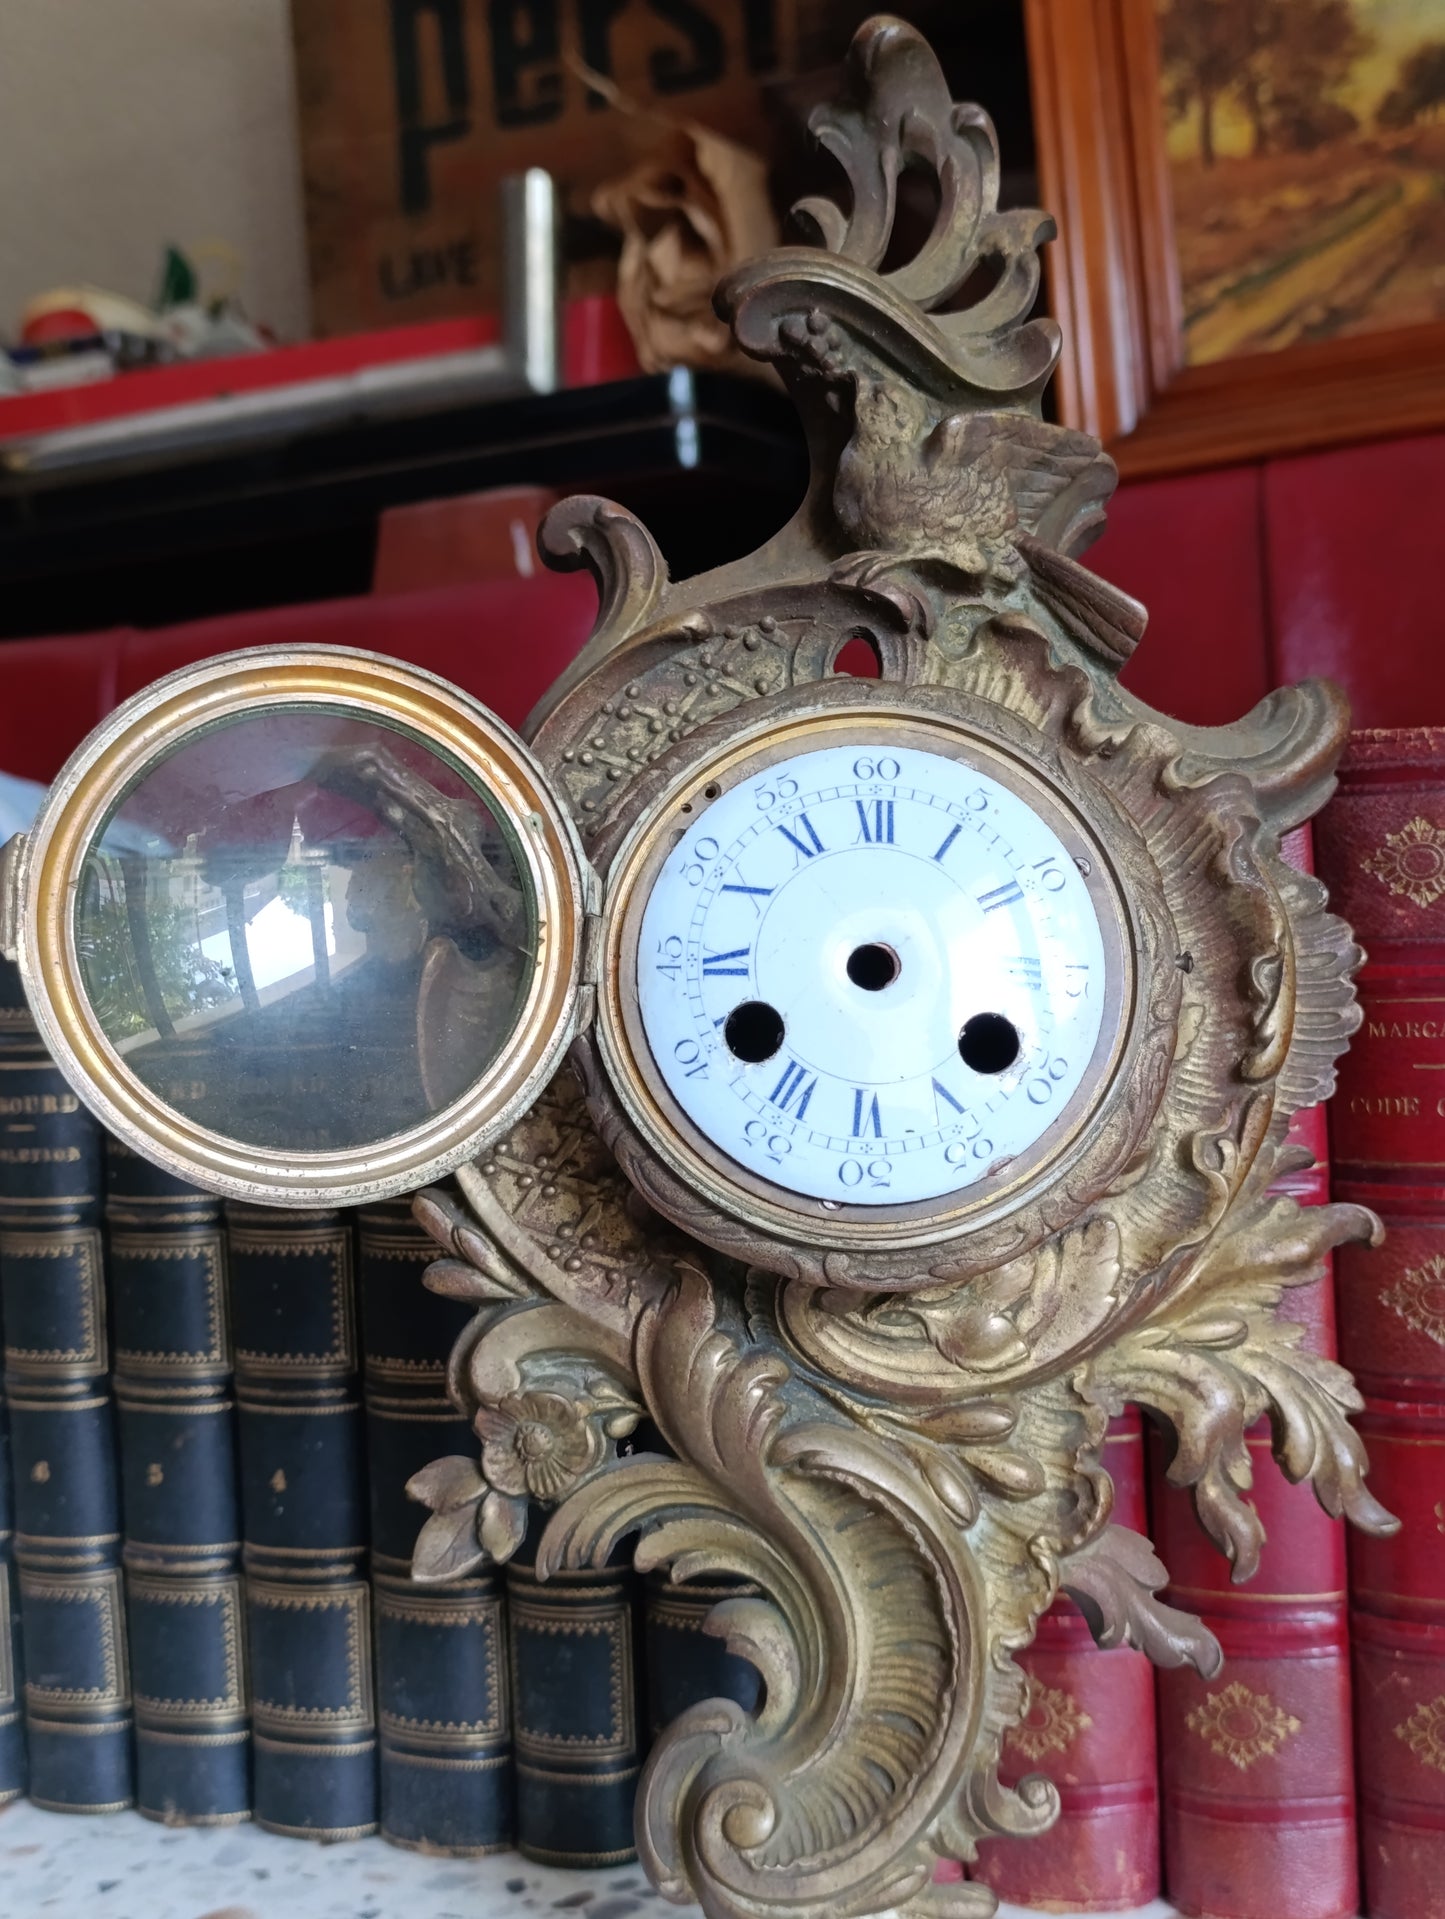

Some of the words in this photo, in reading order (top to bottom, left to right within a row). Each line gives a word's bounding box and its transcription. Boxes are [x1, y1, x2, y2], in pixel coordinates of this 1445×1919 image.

[853, 756, 900, 781] 60
[754, 772, 798, 811] 55
[965, 787, 993, 811] 5
[772, 811, 831, 870] XI
[850, 799, 901, 846] XII
[680, 837, 719, 886] 50
[1032, 857, 1066, 892] 10
[718, 862, 778, 919] X
[656, 935, 683, 981] 45
[703, 942, 751, 982] IX
[675, 1039, 709, 1080] 40
[848, 1087, 888, 1138] VI
[739, 1120, 793, 1165] 35
[838, 1158, 893, 1188] 30
